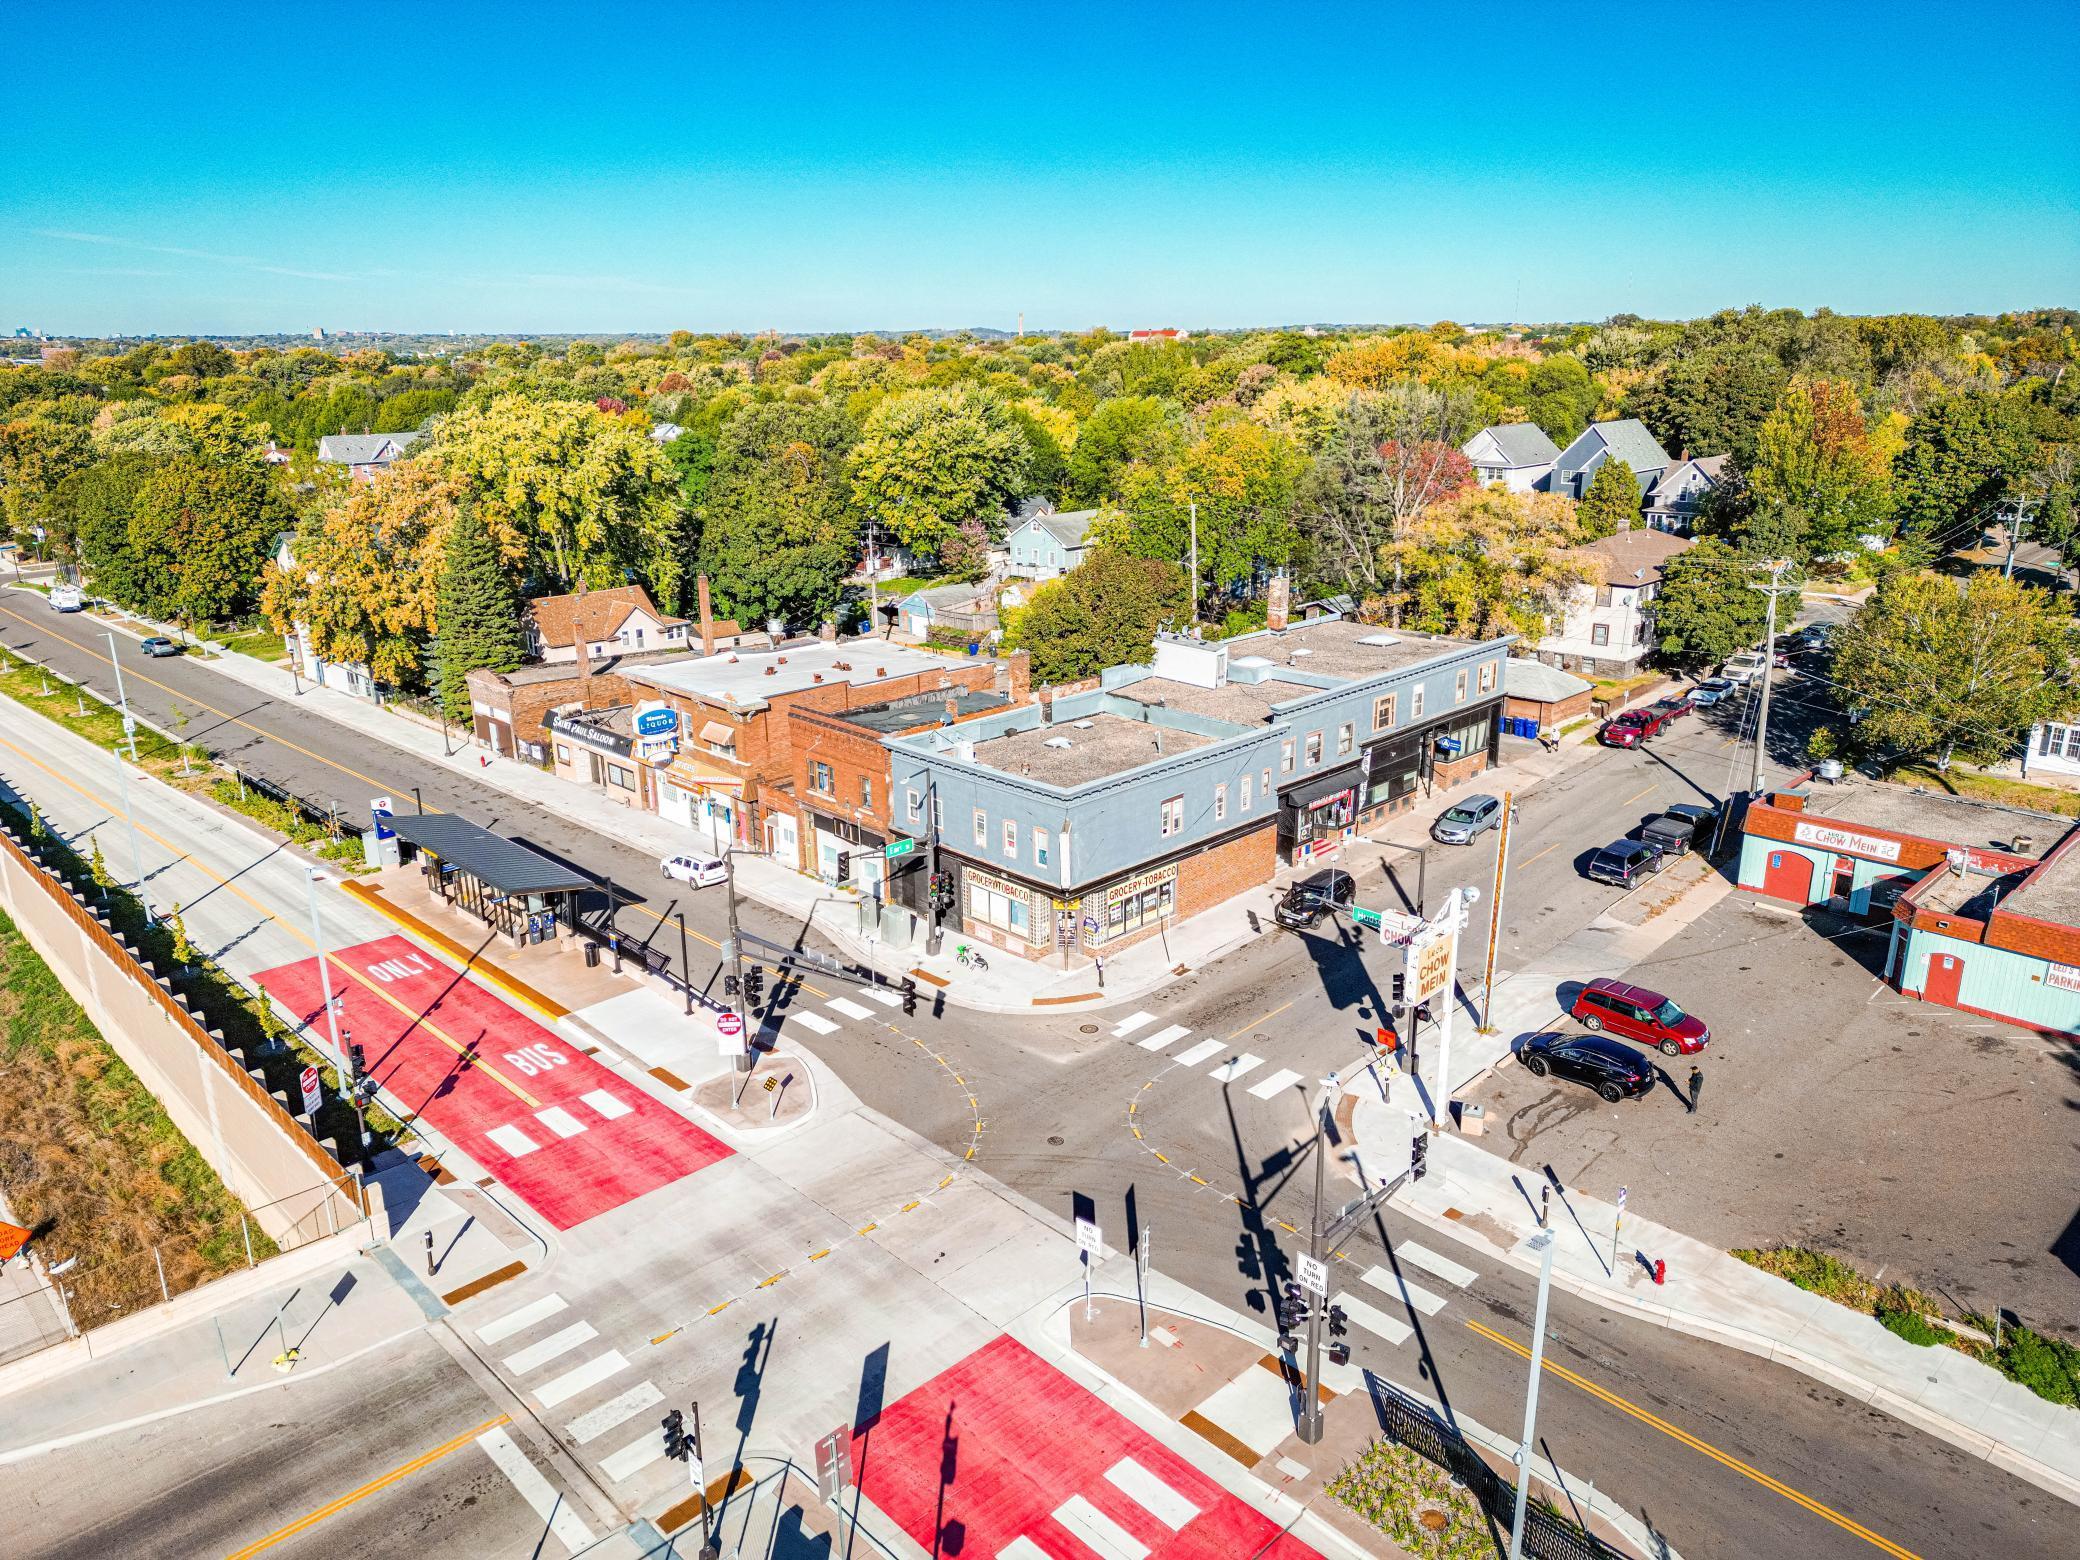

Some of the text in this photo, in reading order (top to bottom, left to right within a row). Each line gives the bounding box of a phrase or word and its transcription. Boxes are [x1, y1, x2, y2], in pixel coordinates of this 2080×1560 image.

[570, 722, 588, 737] PAUL
[586, 728, 616, 746] SALOON
[640, 718, 674, 730] LIQUOR
[1815, 829, 1878, 854] CHOW MEIN
[1109, 866, 1176, 901] GROCERY-TOBACCO
[1384, 928, 1413, 946] CHOW
[367, 953, 433, 983] ONLY
[1419, 952, 1450, 980] CHOW
[1420, 970, 1446, 996] MEIN
[503, 1042, 570, 1077] BUS
[1083, 1225, 1093, 1234] NO
[1303, 1267, 1321, 1282] TURN
[1306, 1260, 1318, 1271] NO
[1298, 1274, 1324, 1292] ON RED
